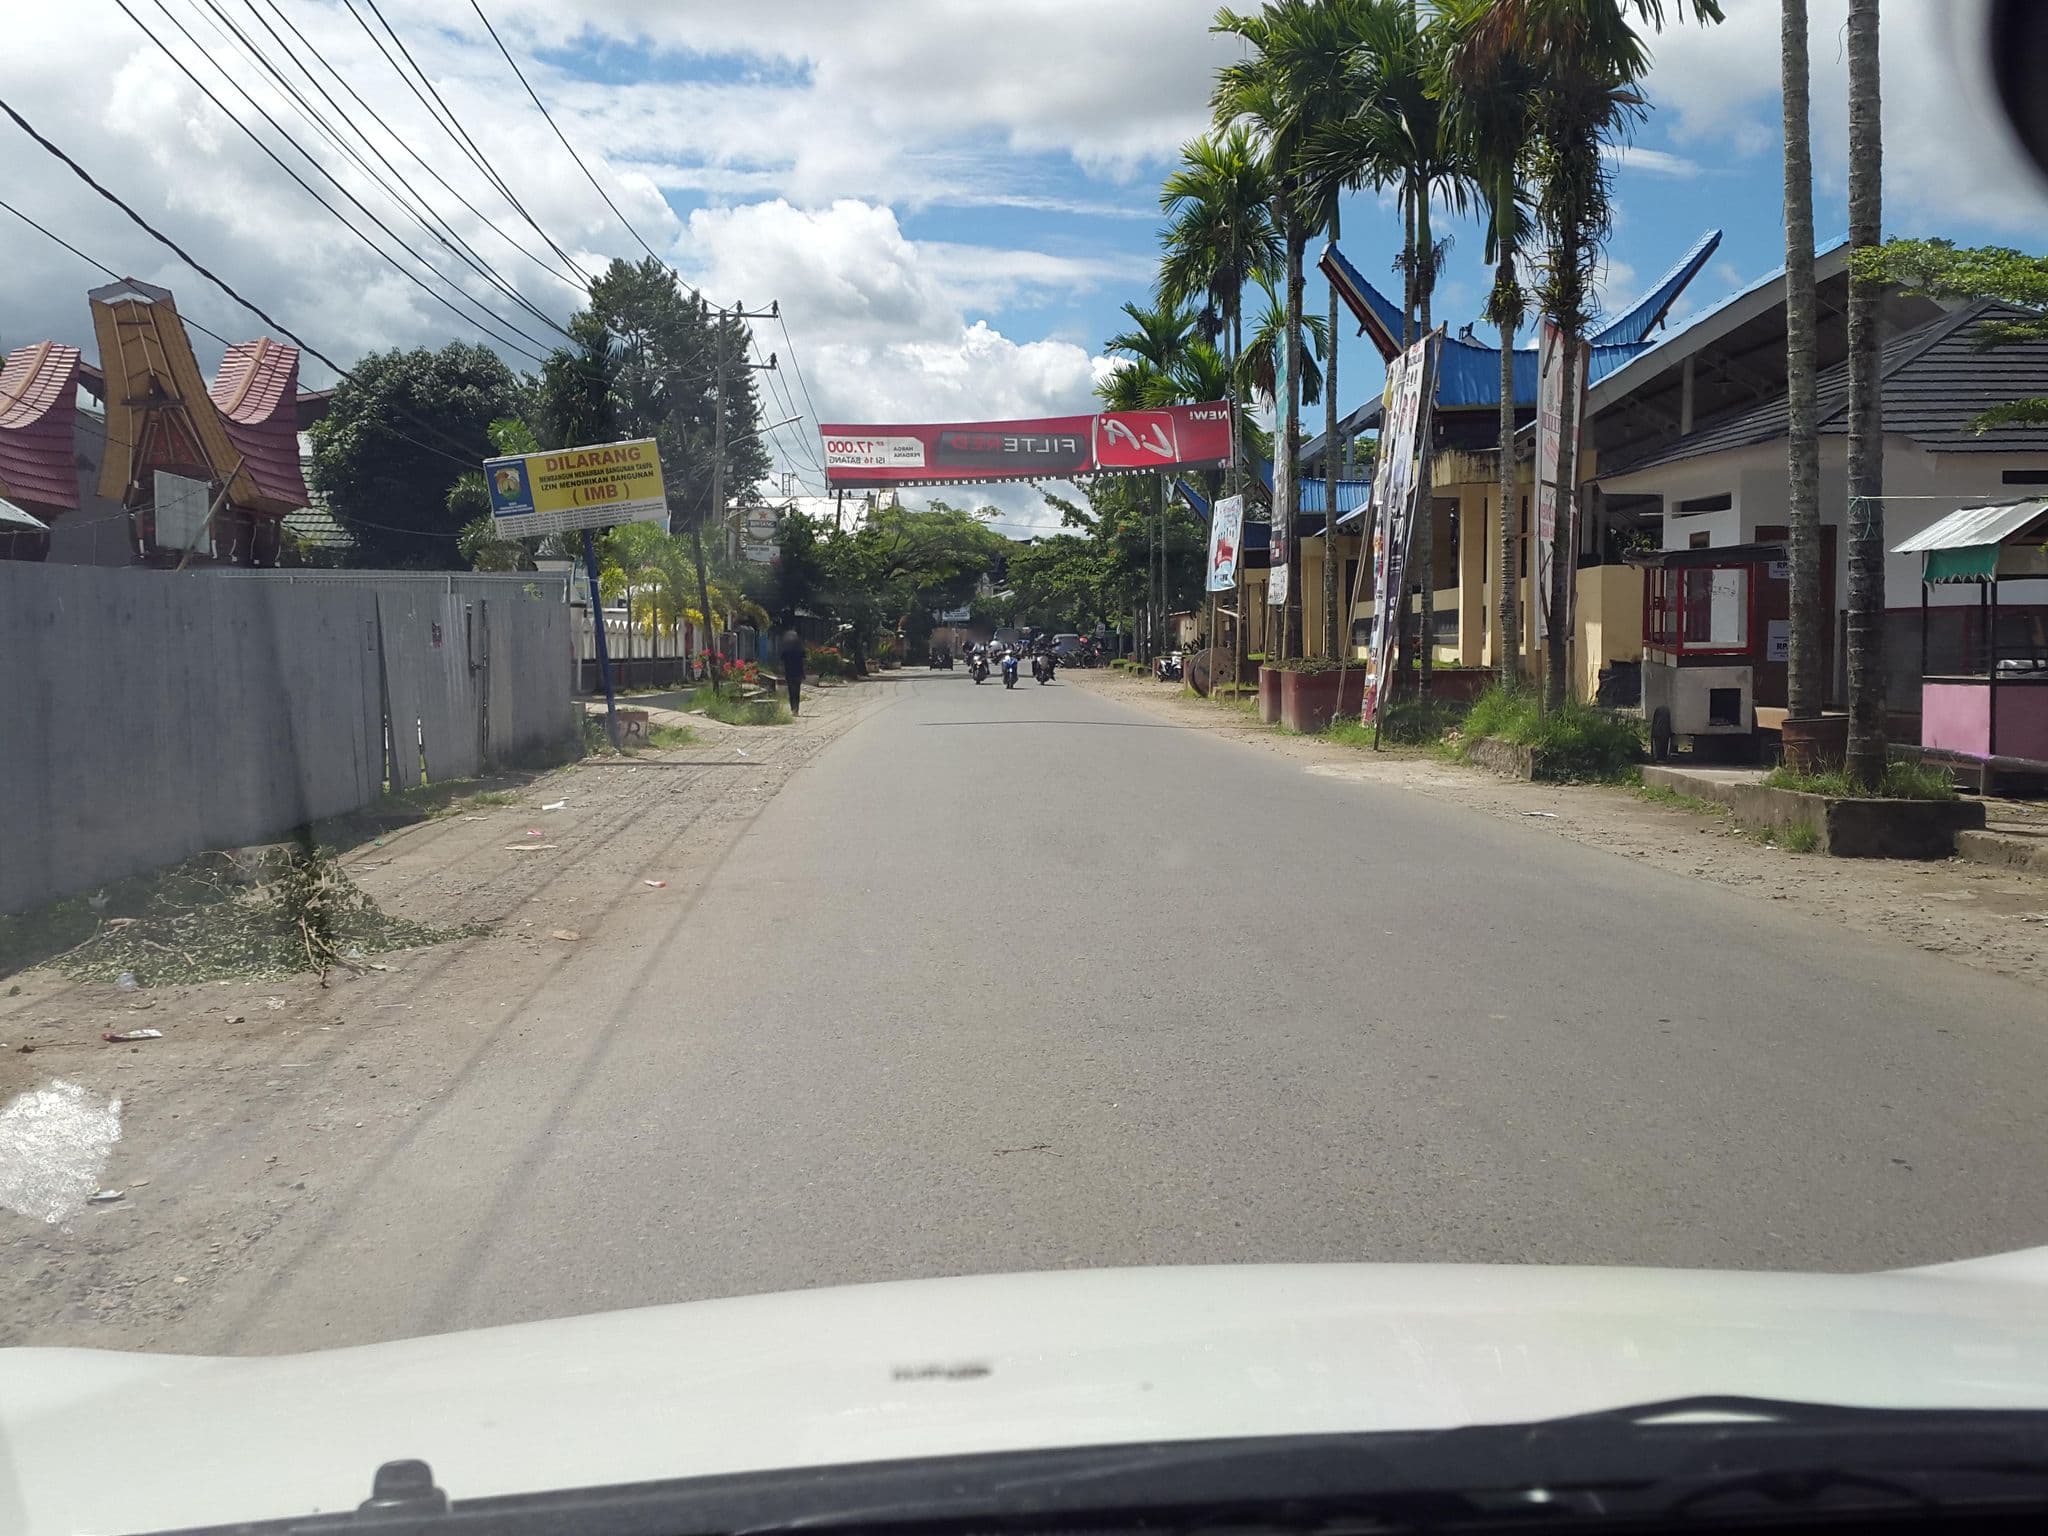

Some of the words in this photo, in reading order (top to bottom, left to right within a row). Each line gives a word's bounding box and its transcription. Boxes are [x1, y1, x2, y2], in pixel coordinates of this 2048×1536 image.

[545, 447, 641, 472] DILARANG
[541, 483, 558, 492] IZIN
[559, 477, 609, 489] MENDIRIKAN
[610, 470, 654, 482] BANGUNAN
